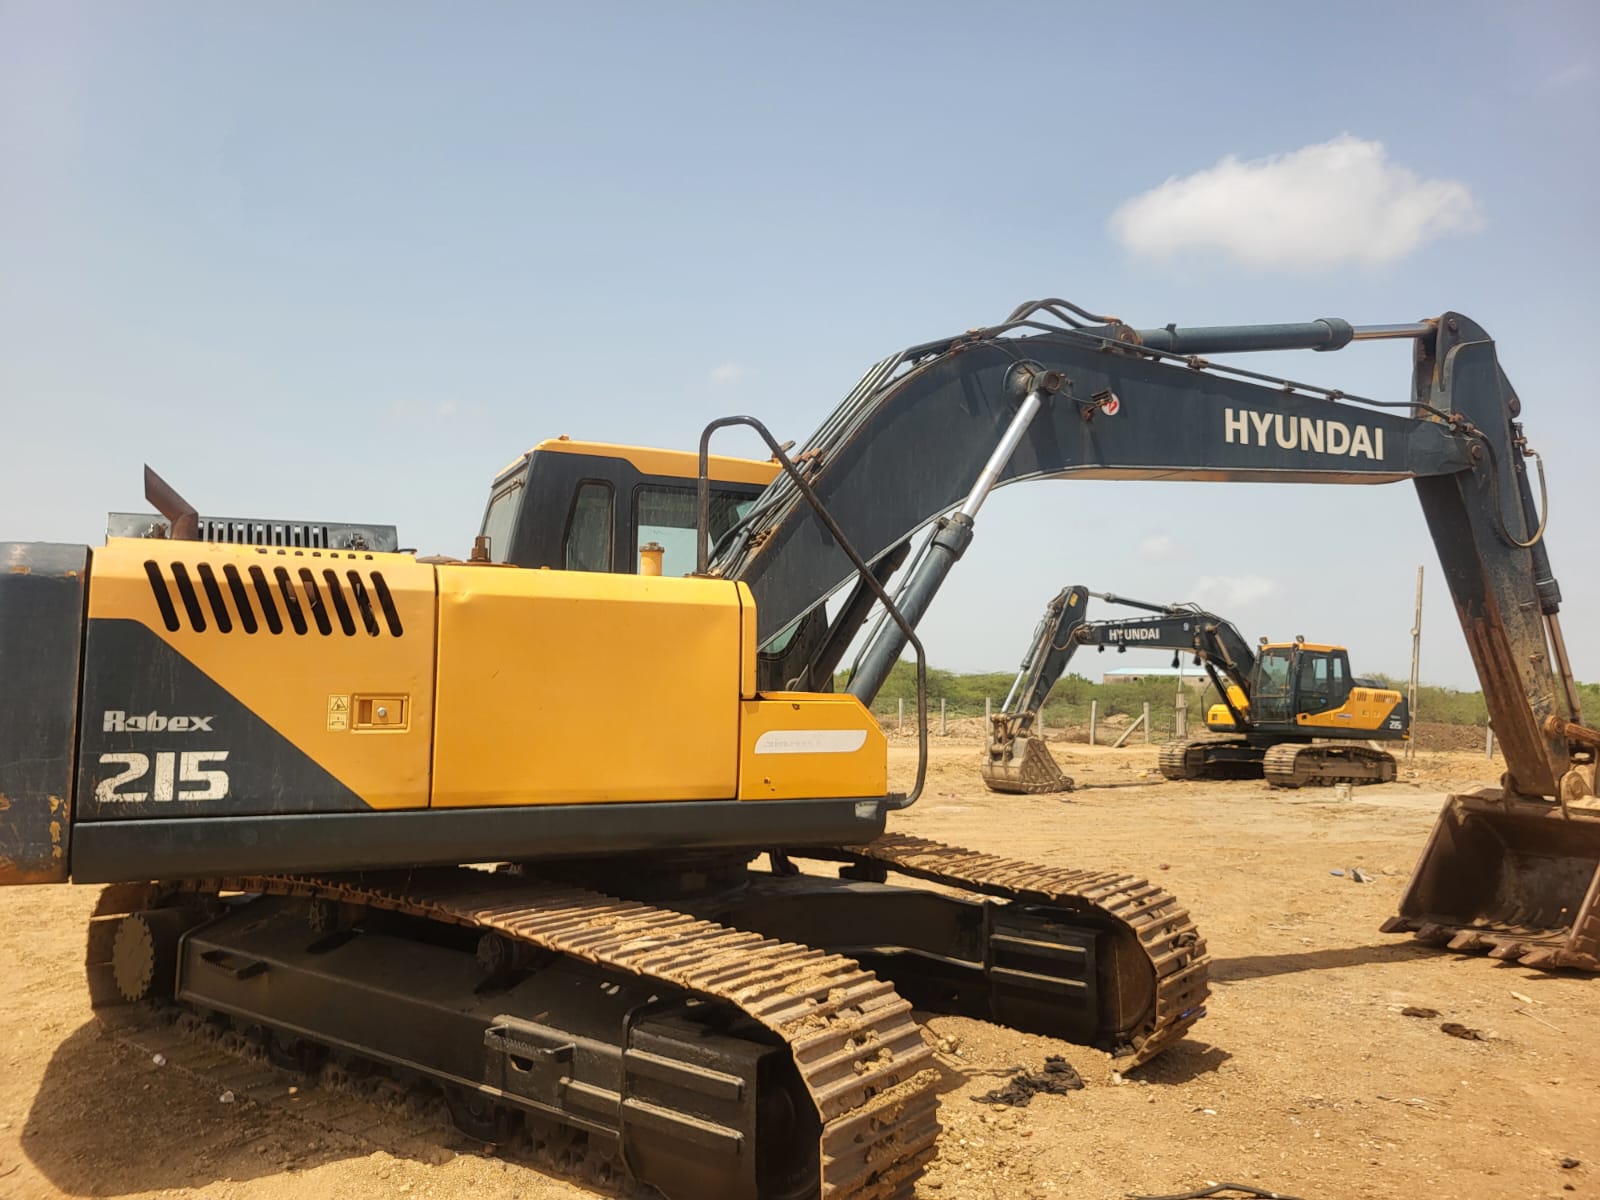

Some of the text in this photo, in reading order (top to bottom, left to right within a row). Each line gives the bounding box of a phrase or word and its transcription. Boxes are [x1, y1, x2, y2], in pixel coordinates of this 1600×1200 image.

[1224, 407, 1384, 461] HYUNDAI
[1108, 628, 1160, 641] HYUNDAI
[95, 751, 230, 802] 215
